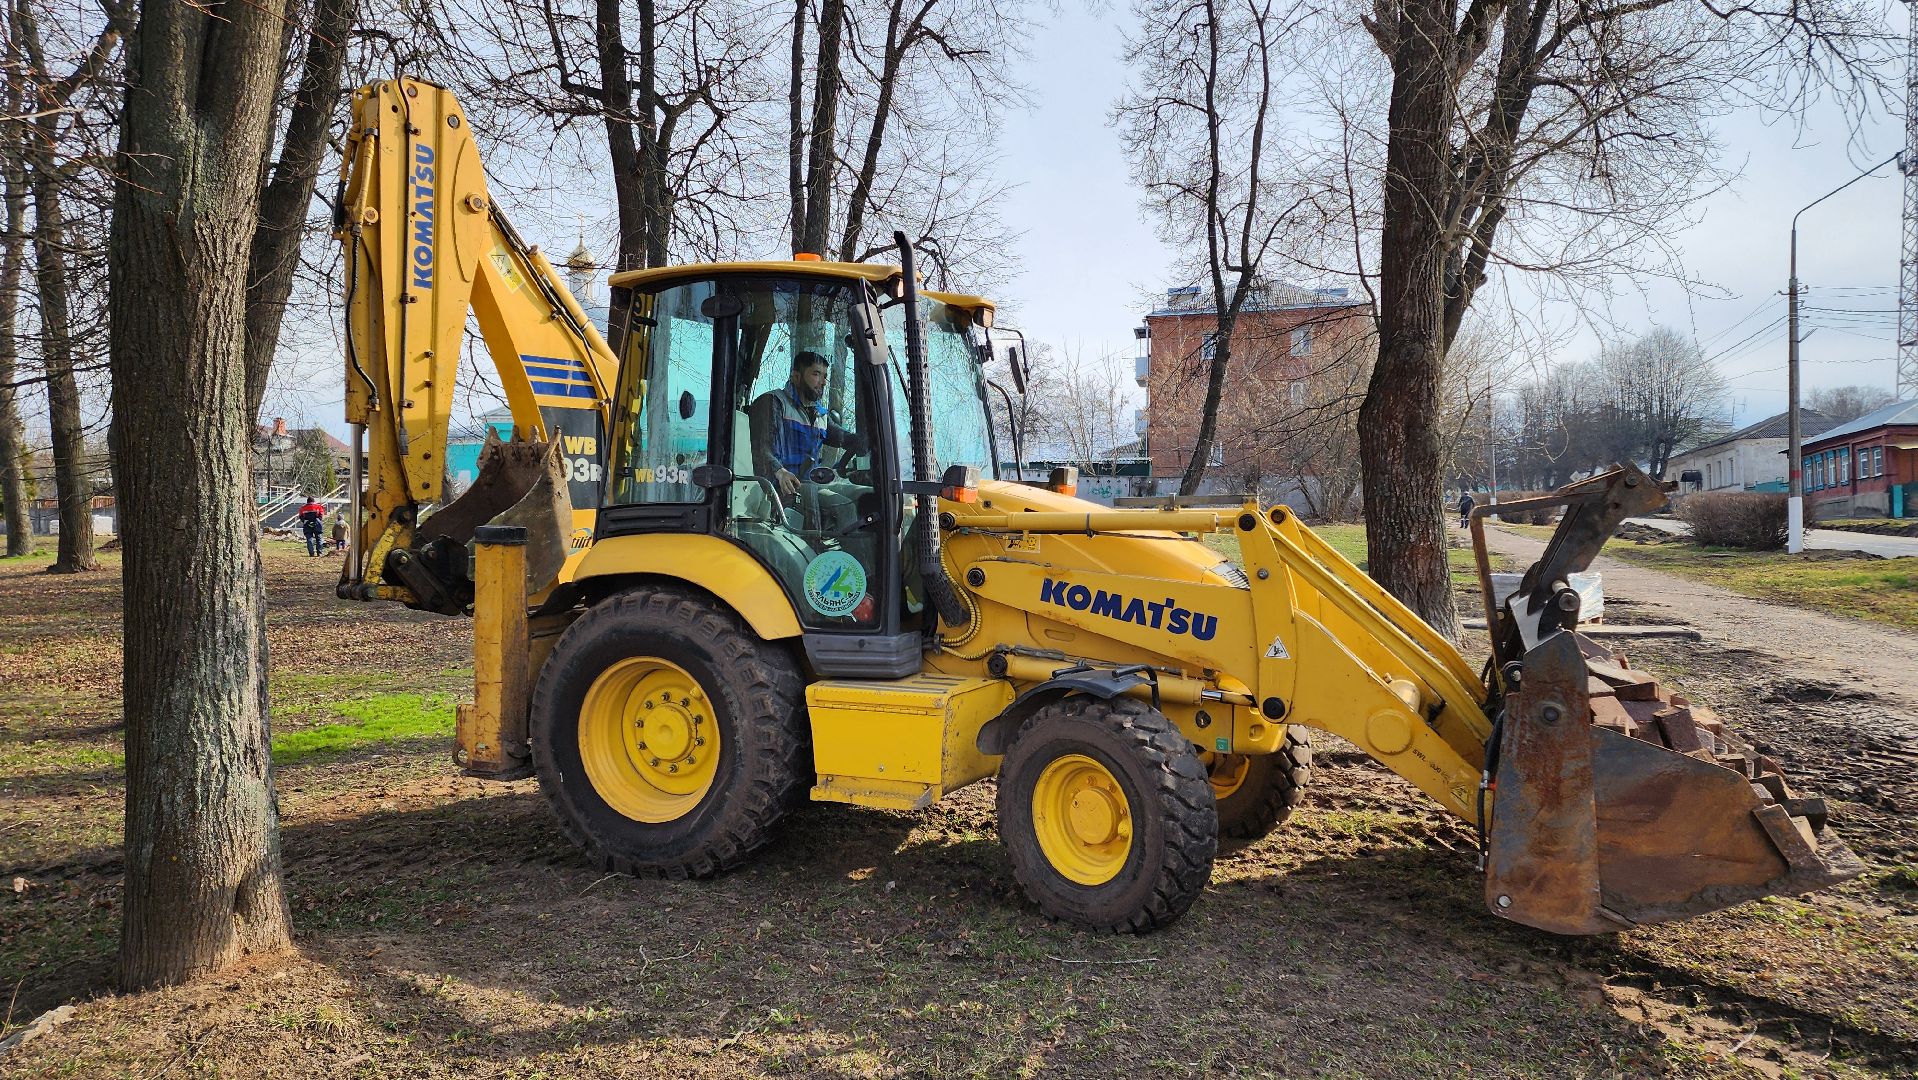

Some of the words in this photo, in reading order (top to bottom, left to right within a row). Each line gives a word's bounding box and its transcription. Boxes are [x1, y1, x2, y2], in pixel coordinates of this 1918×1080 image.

[410, 144, 434, 289] KOMATSU
[564, 436, 597, 455] WB
[1040, 578, 1218, 641] KOMATSU
